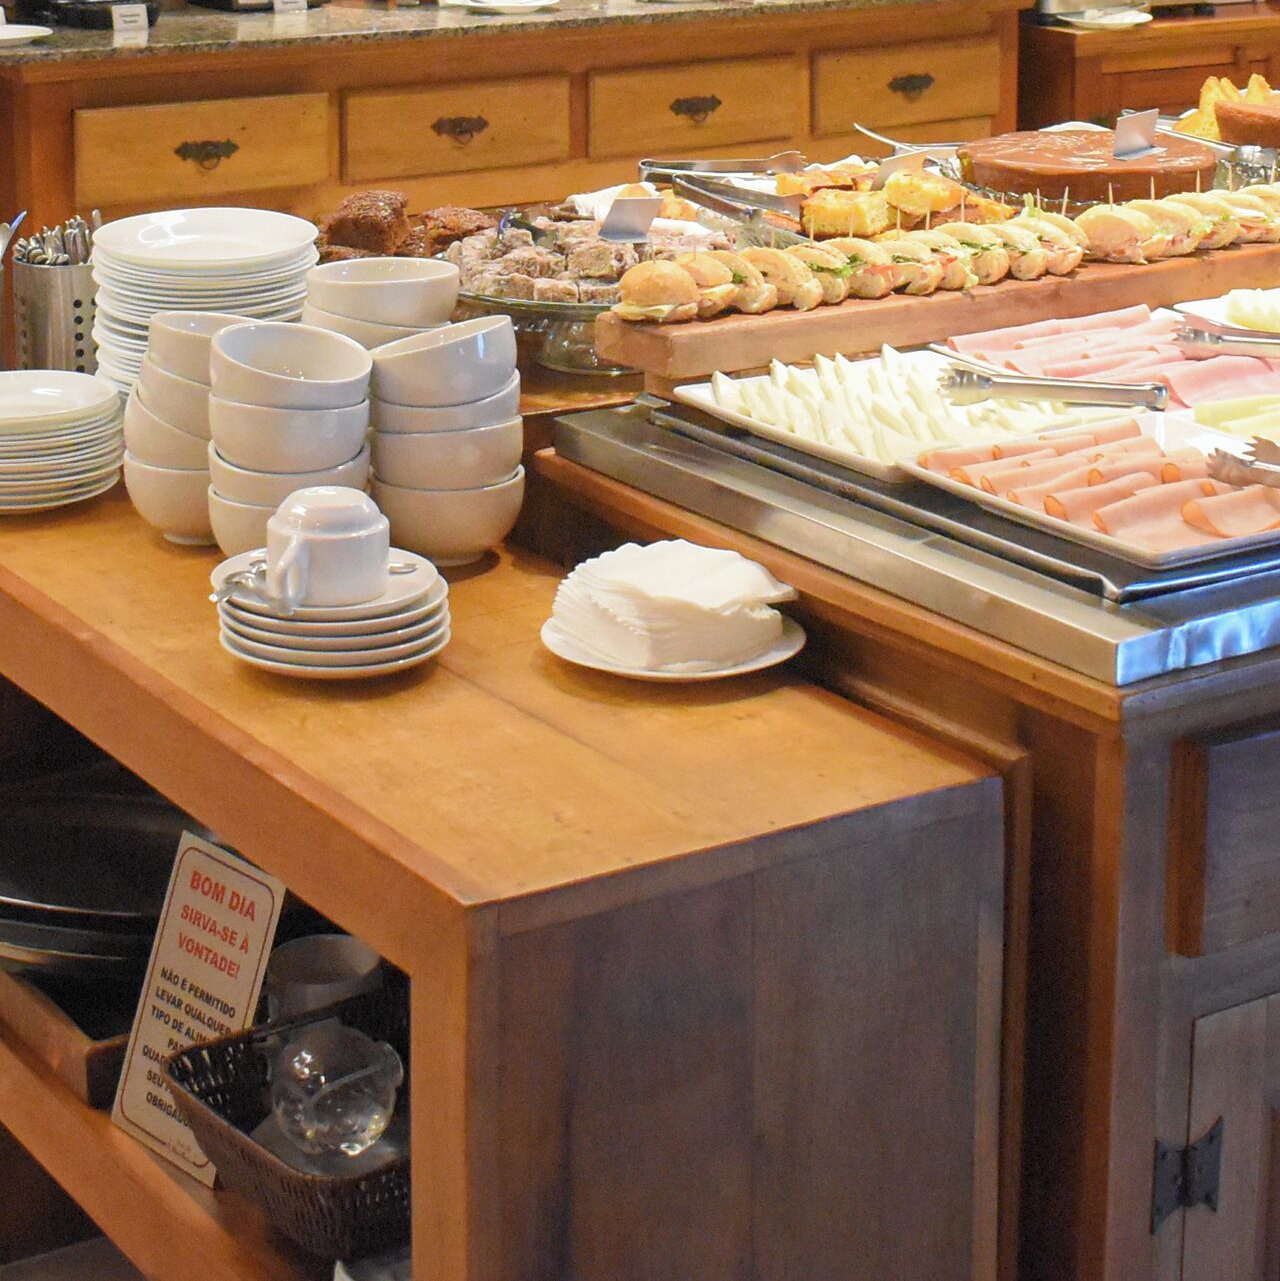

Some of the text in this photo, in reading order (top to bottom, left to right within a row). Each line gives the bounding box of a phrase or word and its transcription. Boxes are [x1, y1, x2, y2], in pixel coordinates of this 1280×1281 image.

[190, 870, 256, 922] BOM DIA
[180, 904, 238, 947] SIRVA-SE
[178, 932, 241, 979] VONTADE!
[155, 986, 183, 1010] LEVAR
[161, 967, 236, 1018] NÃO É PERMITIDO
[151, 1005, 171, 1025] TIPO
[172, 1018, 184, 1034] DE
[147, 1070, 164, 1087] SEU
